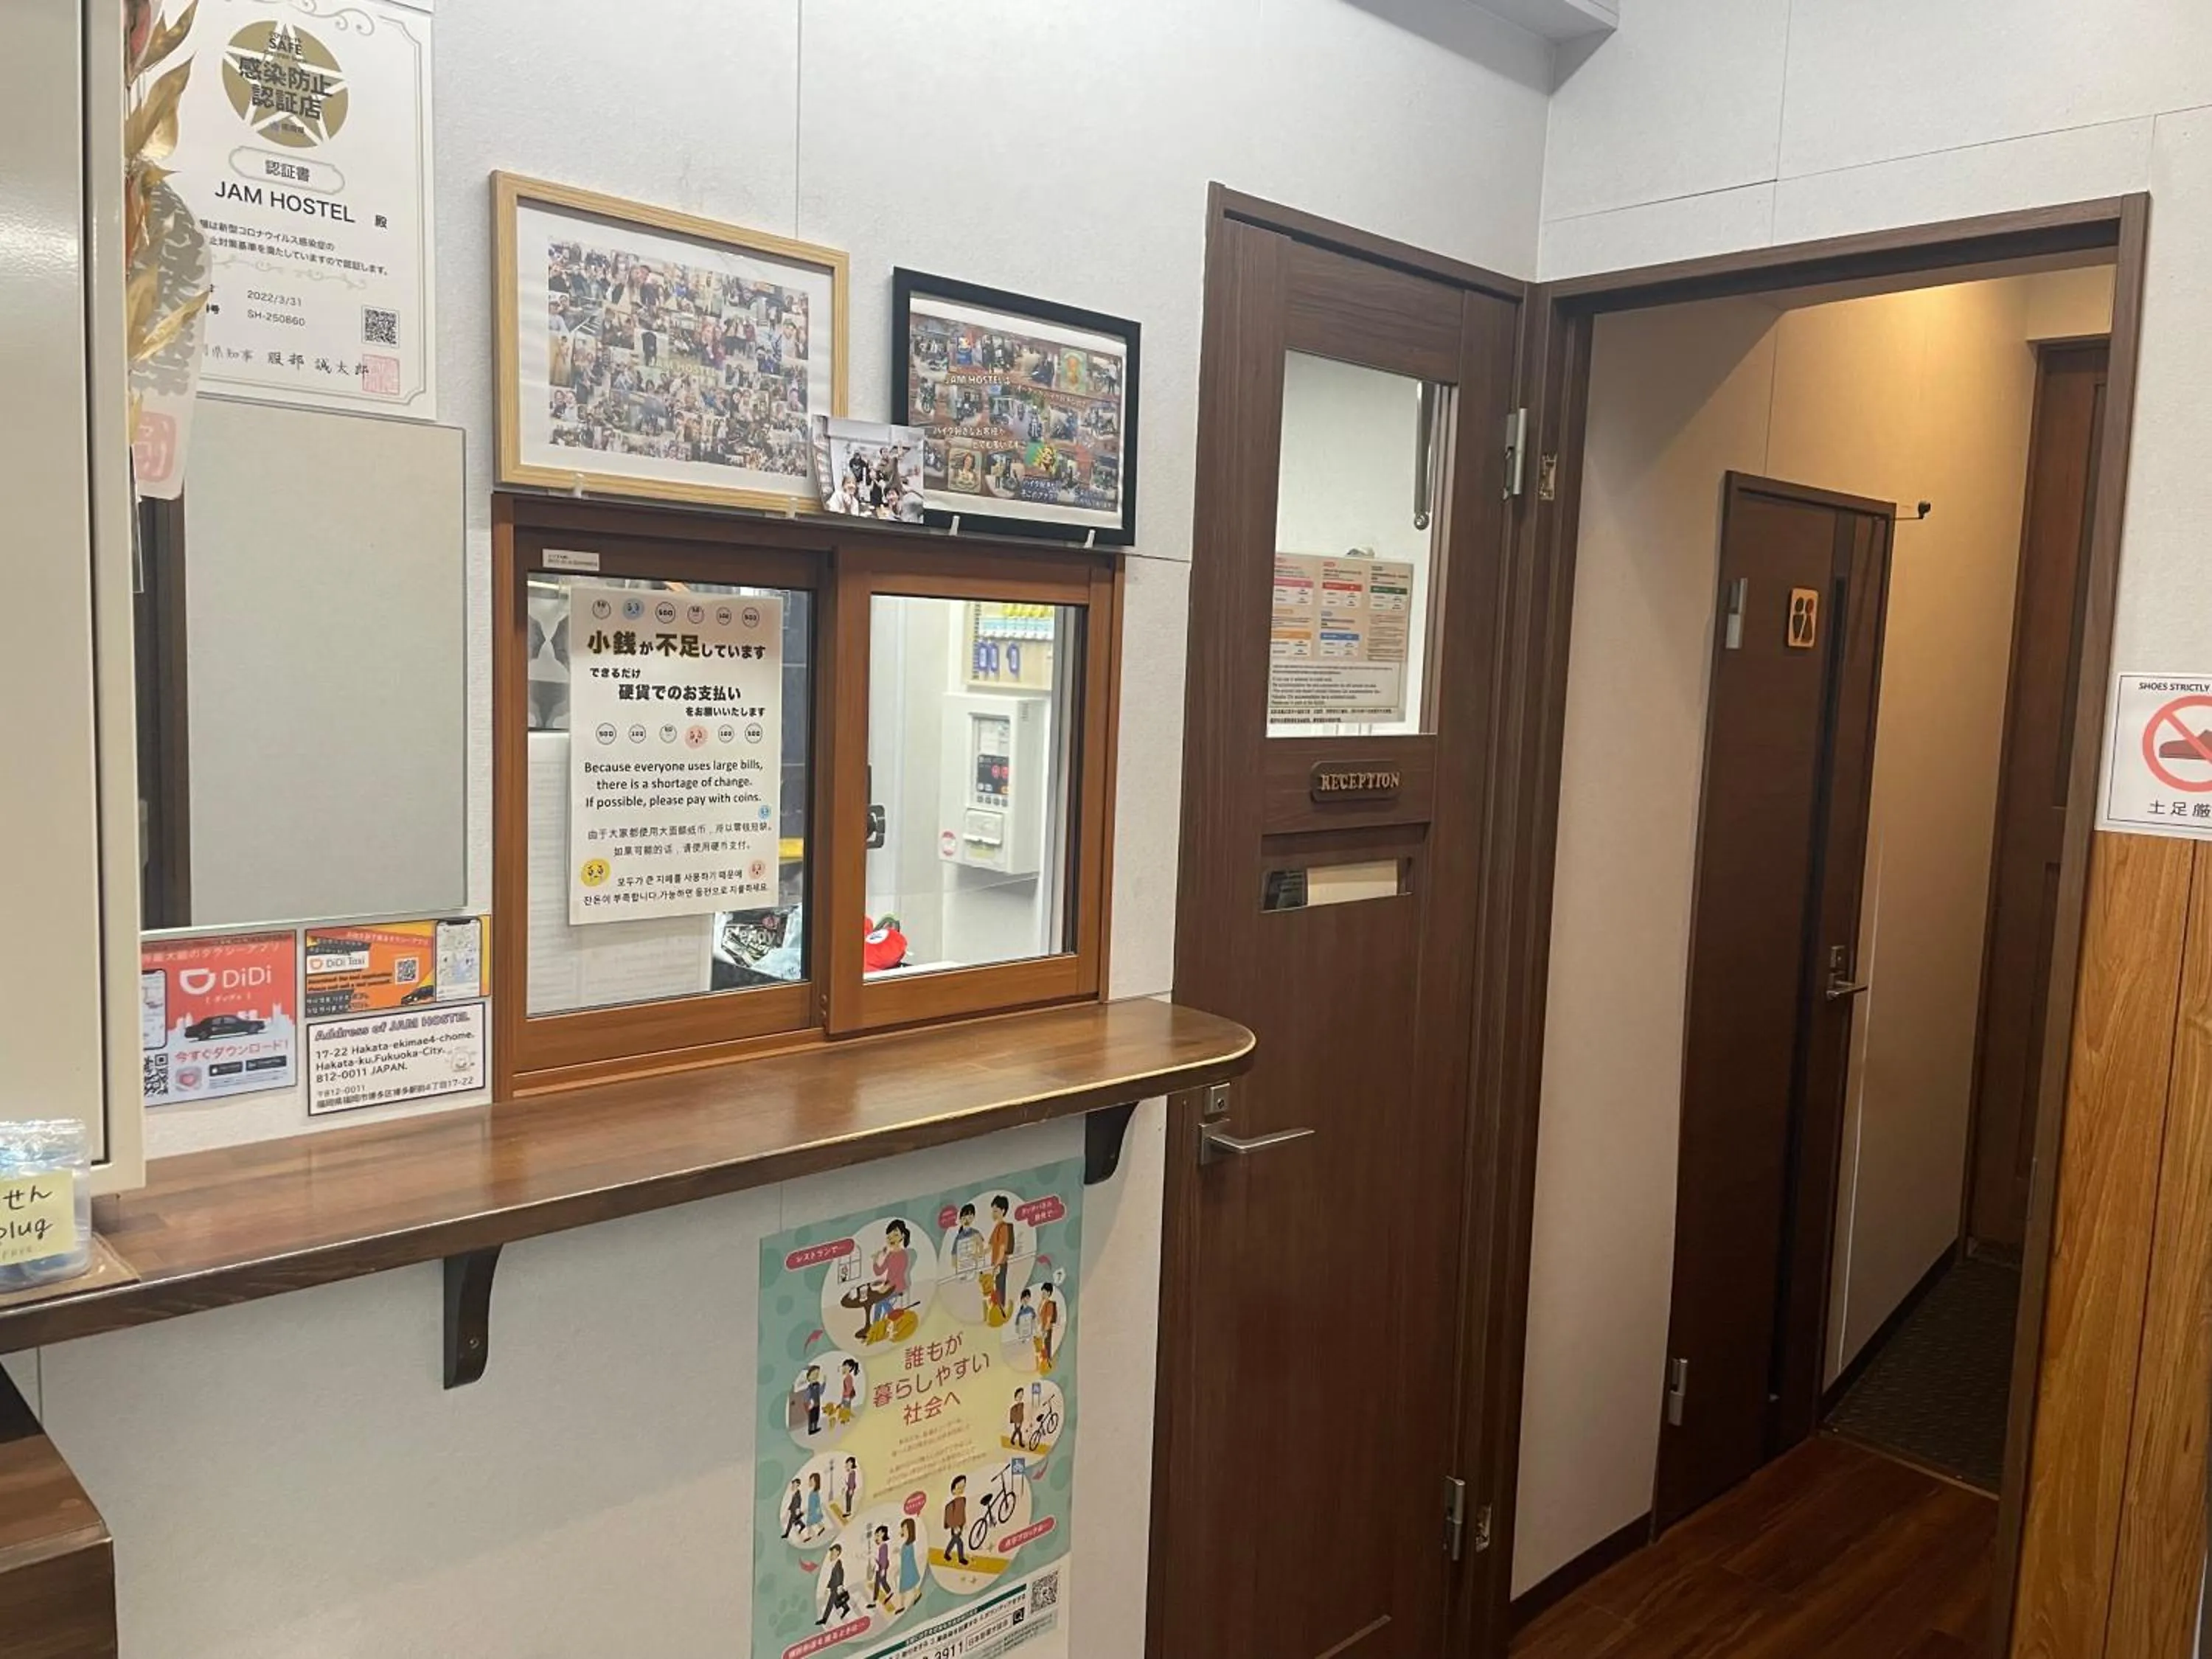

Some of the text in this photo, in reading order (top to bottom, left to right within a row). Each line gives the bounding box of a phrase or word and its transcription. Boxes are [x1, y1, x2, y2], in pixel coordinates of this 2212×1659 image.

[269, 38, 302, 55] SAFE
[240, 57, 333, 97] 感染防止
[251, 84, 322, 120] 認証店
[265, 160, 310, 182] 認証書
[215, 181, 355, 223] JAM HOSTEL
[375, 214, 388, 229] 殿
[247, 290, 303, 307] 2022/3/31
[587, 630, 767, 660] 小銭が不足しています
[589, 667, 641, 679] できるだけ
[618, 684, 742, 701] 硬貨でのお支払い
[2138, 681, 2211, 692] SHOES STRICTLY
[685, 706, 767, 717] をお願いいたします
[585, 759, 764, 774] Because everyone uses large bills,
[597, 779, 627, 790] there
[630, 779, 640, 789] is
[651, 777, 699, 790] shortage
[701, 777, 713, 787] of
[714, 776, 753, 787] change.
[1320, 771, 1400, 791] RECEPTION
[585, 791, 762, 810] If possible, please pay with coins.
[2147, 799, 2211, 818] 土足厳
[223, 964, 271, 989] DiDi
[315, 1026, 369, 1042] Address
[371, 1021, 388, 1034] of
[389, 1017, 419, 1032] JAM
[316, 1046, 348, 1060] 17-22
[316, 1062, 408, 1084] 812-0011 JAPAN.
[2, 1184, 53, 1210] せん
[905, 1330, 964, 1371] 誰もが
[873, 1352, 990, 1408] 暮らしやすい
[903, 1391, 961, 1426] 社会へ
